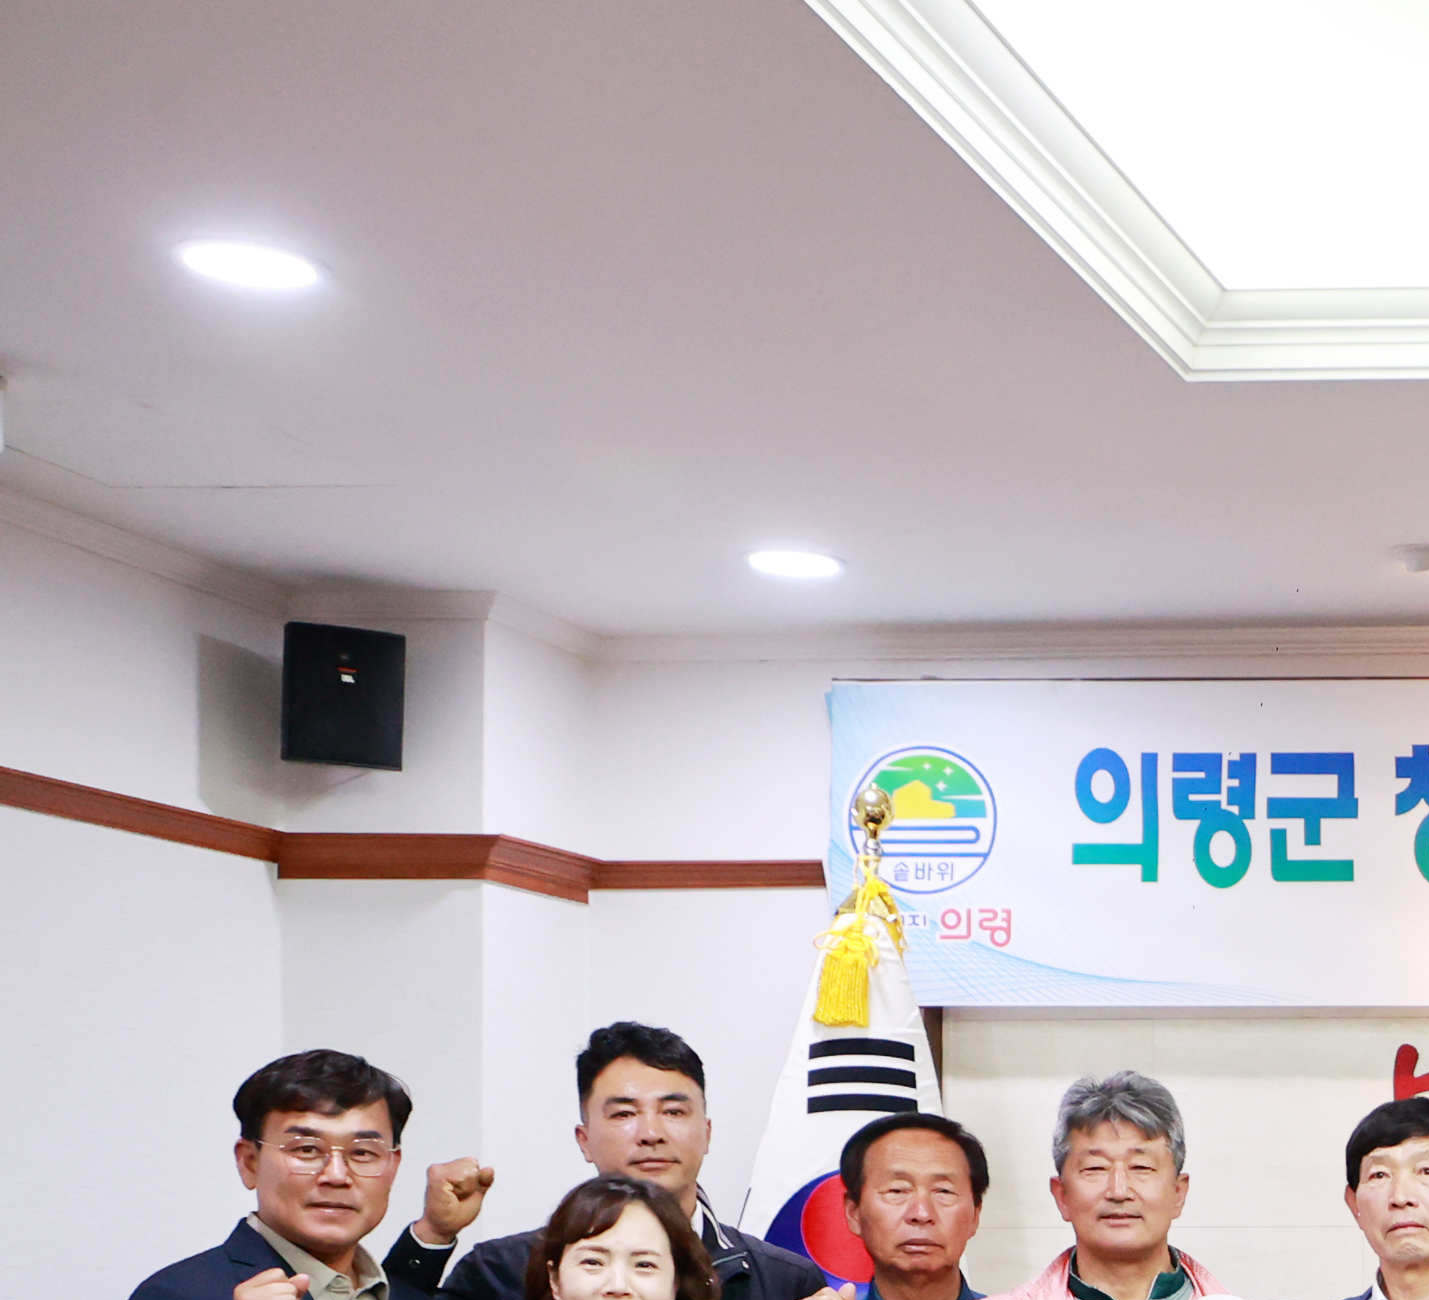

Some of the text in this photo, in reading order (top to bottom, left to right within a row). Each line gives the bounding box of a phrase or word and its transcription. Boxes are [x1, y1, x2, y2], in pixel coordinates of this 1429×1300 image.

[1072, 747, 1360, 889] 의령군
[893, 861, 955, 883] 솥바위
[939, 908, 1012, 947] 의령
